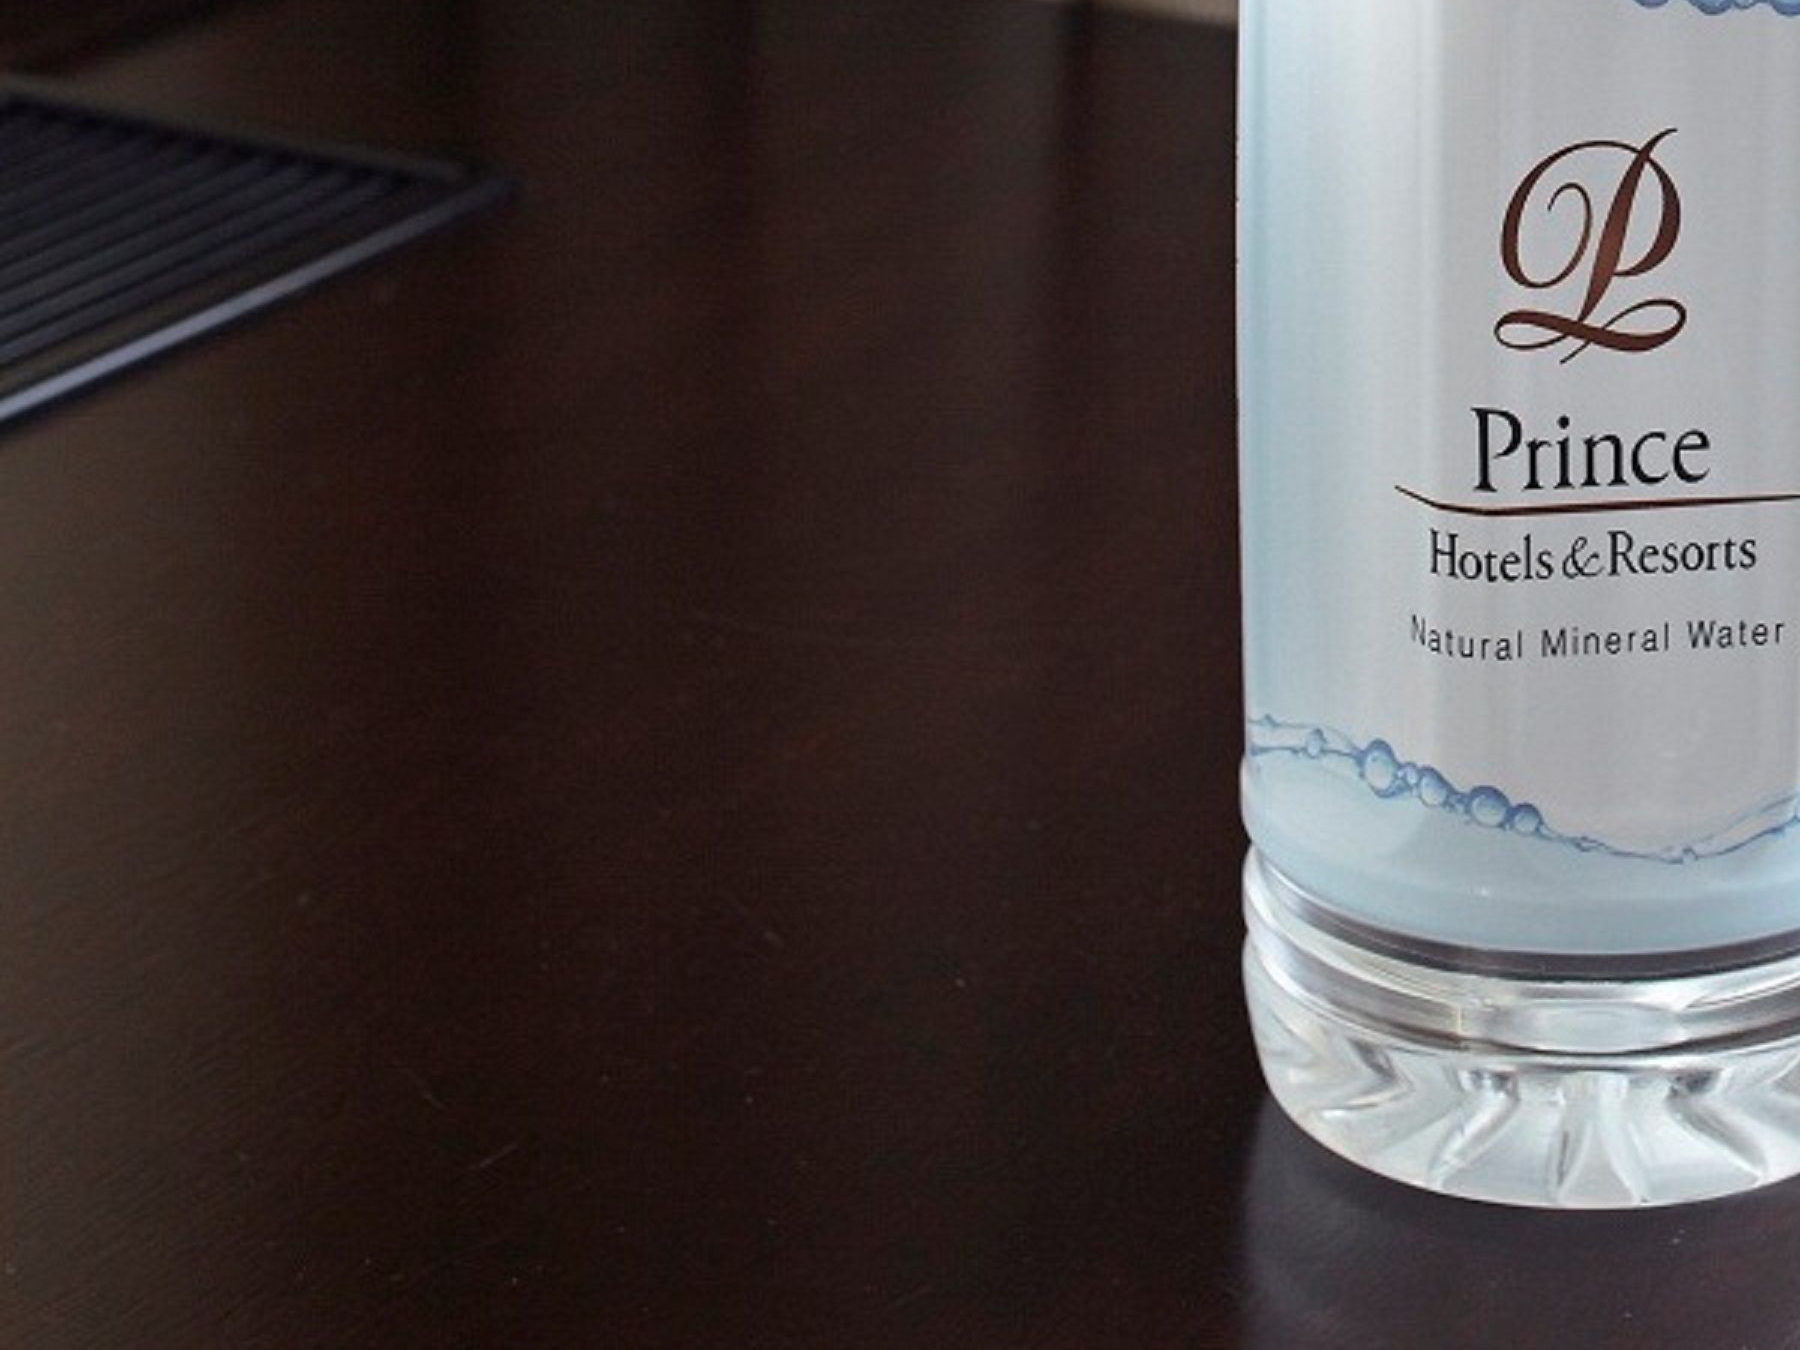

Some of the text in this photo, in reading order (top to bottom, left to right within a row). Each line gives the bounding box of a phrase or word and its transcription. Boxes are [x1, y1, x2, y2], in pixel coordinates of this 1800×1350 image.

[1470, 406, 1711, 493] Prince
[1429, 527, 1554, 583] Hotels
[1606, 529, 1758, 578] Resorts
[1411, 613, 1786, 662] Natural Mineral Water
